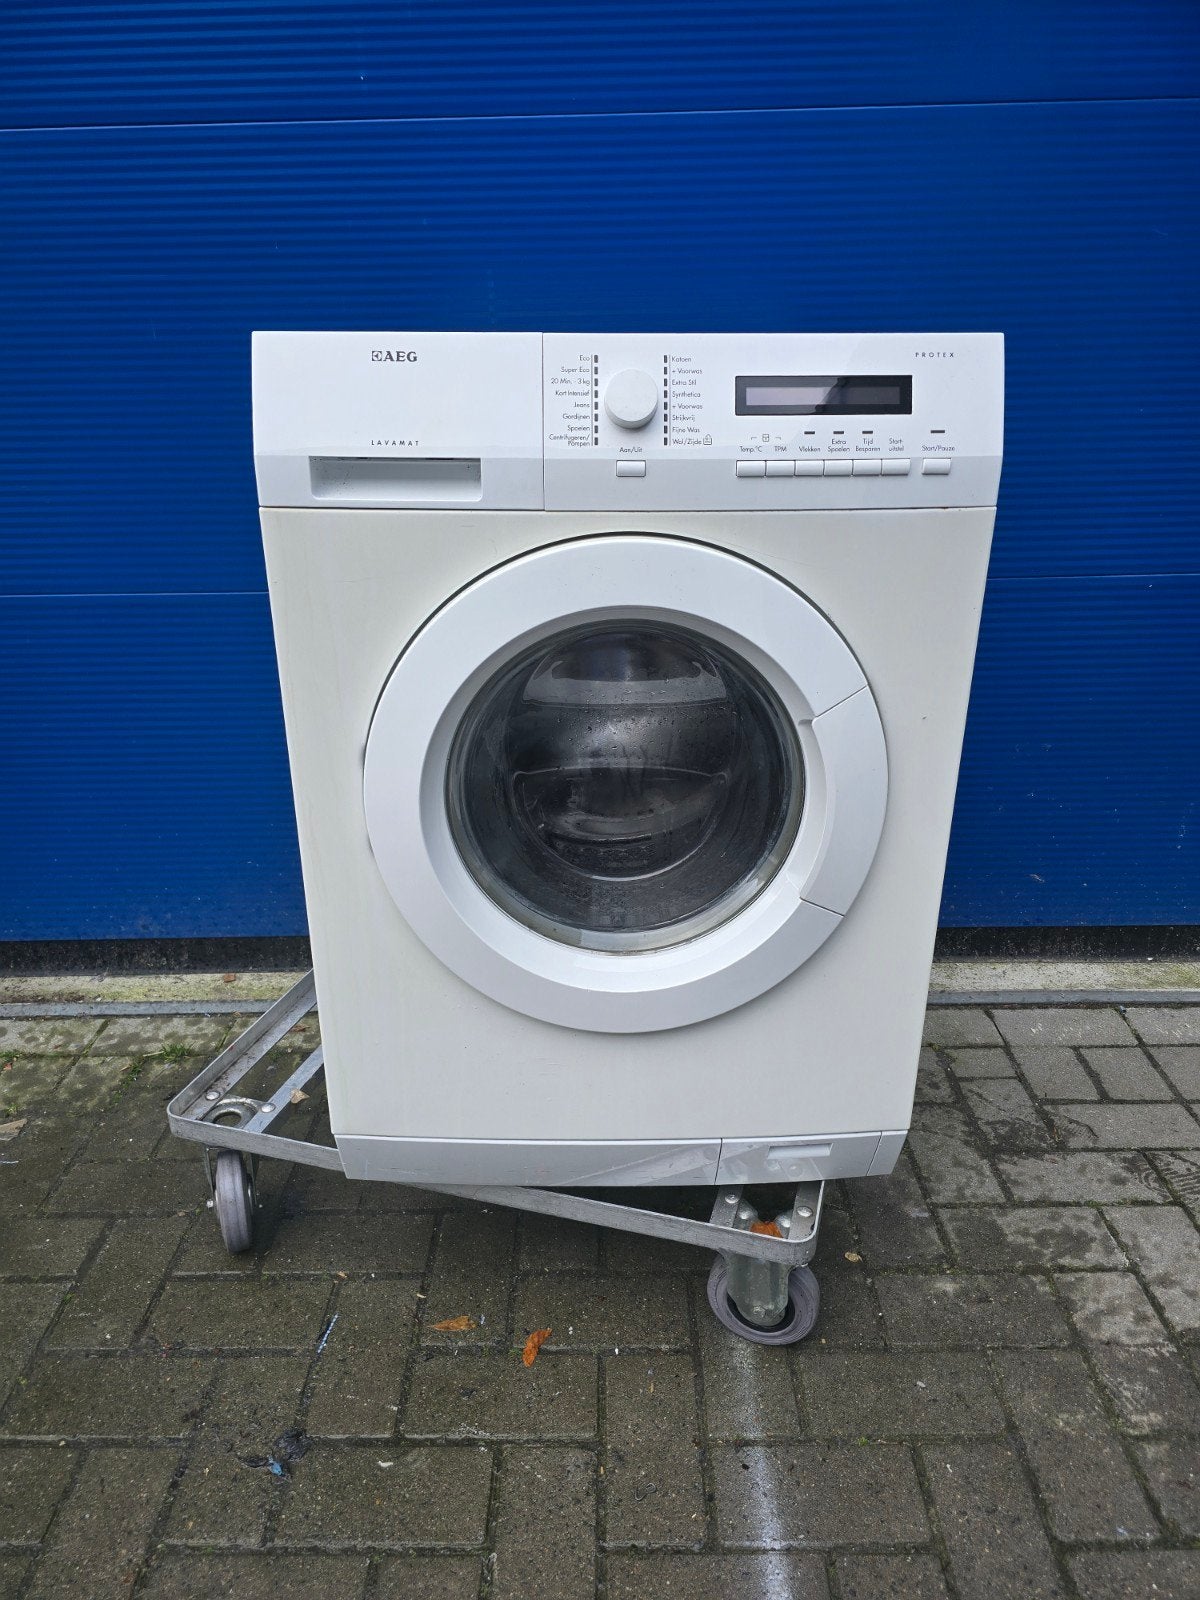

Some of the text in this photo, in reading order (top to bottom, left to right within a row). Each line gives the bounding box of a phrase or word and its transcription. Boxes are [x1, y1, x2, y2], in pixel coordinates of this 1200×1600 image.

[383, 351, 417, 362] AEG
[561, 366, 577, 374] Super
[583, 378, 590, 386] kg
[567, 440, 590, 448] Pompen
[921, 444, 955, 452] Start/Pauze
[855, 445, 880, 453] Besparen
